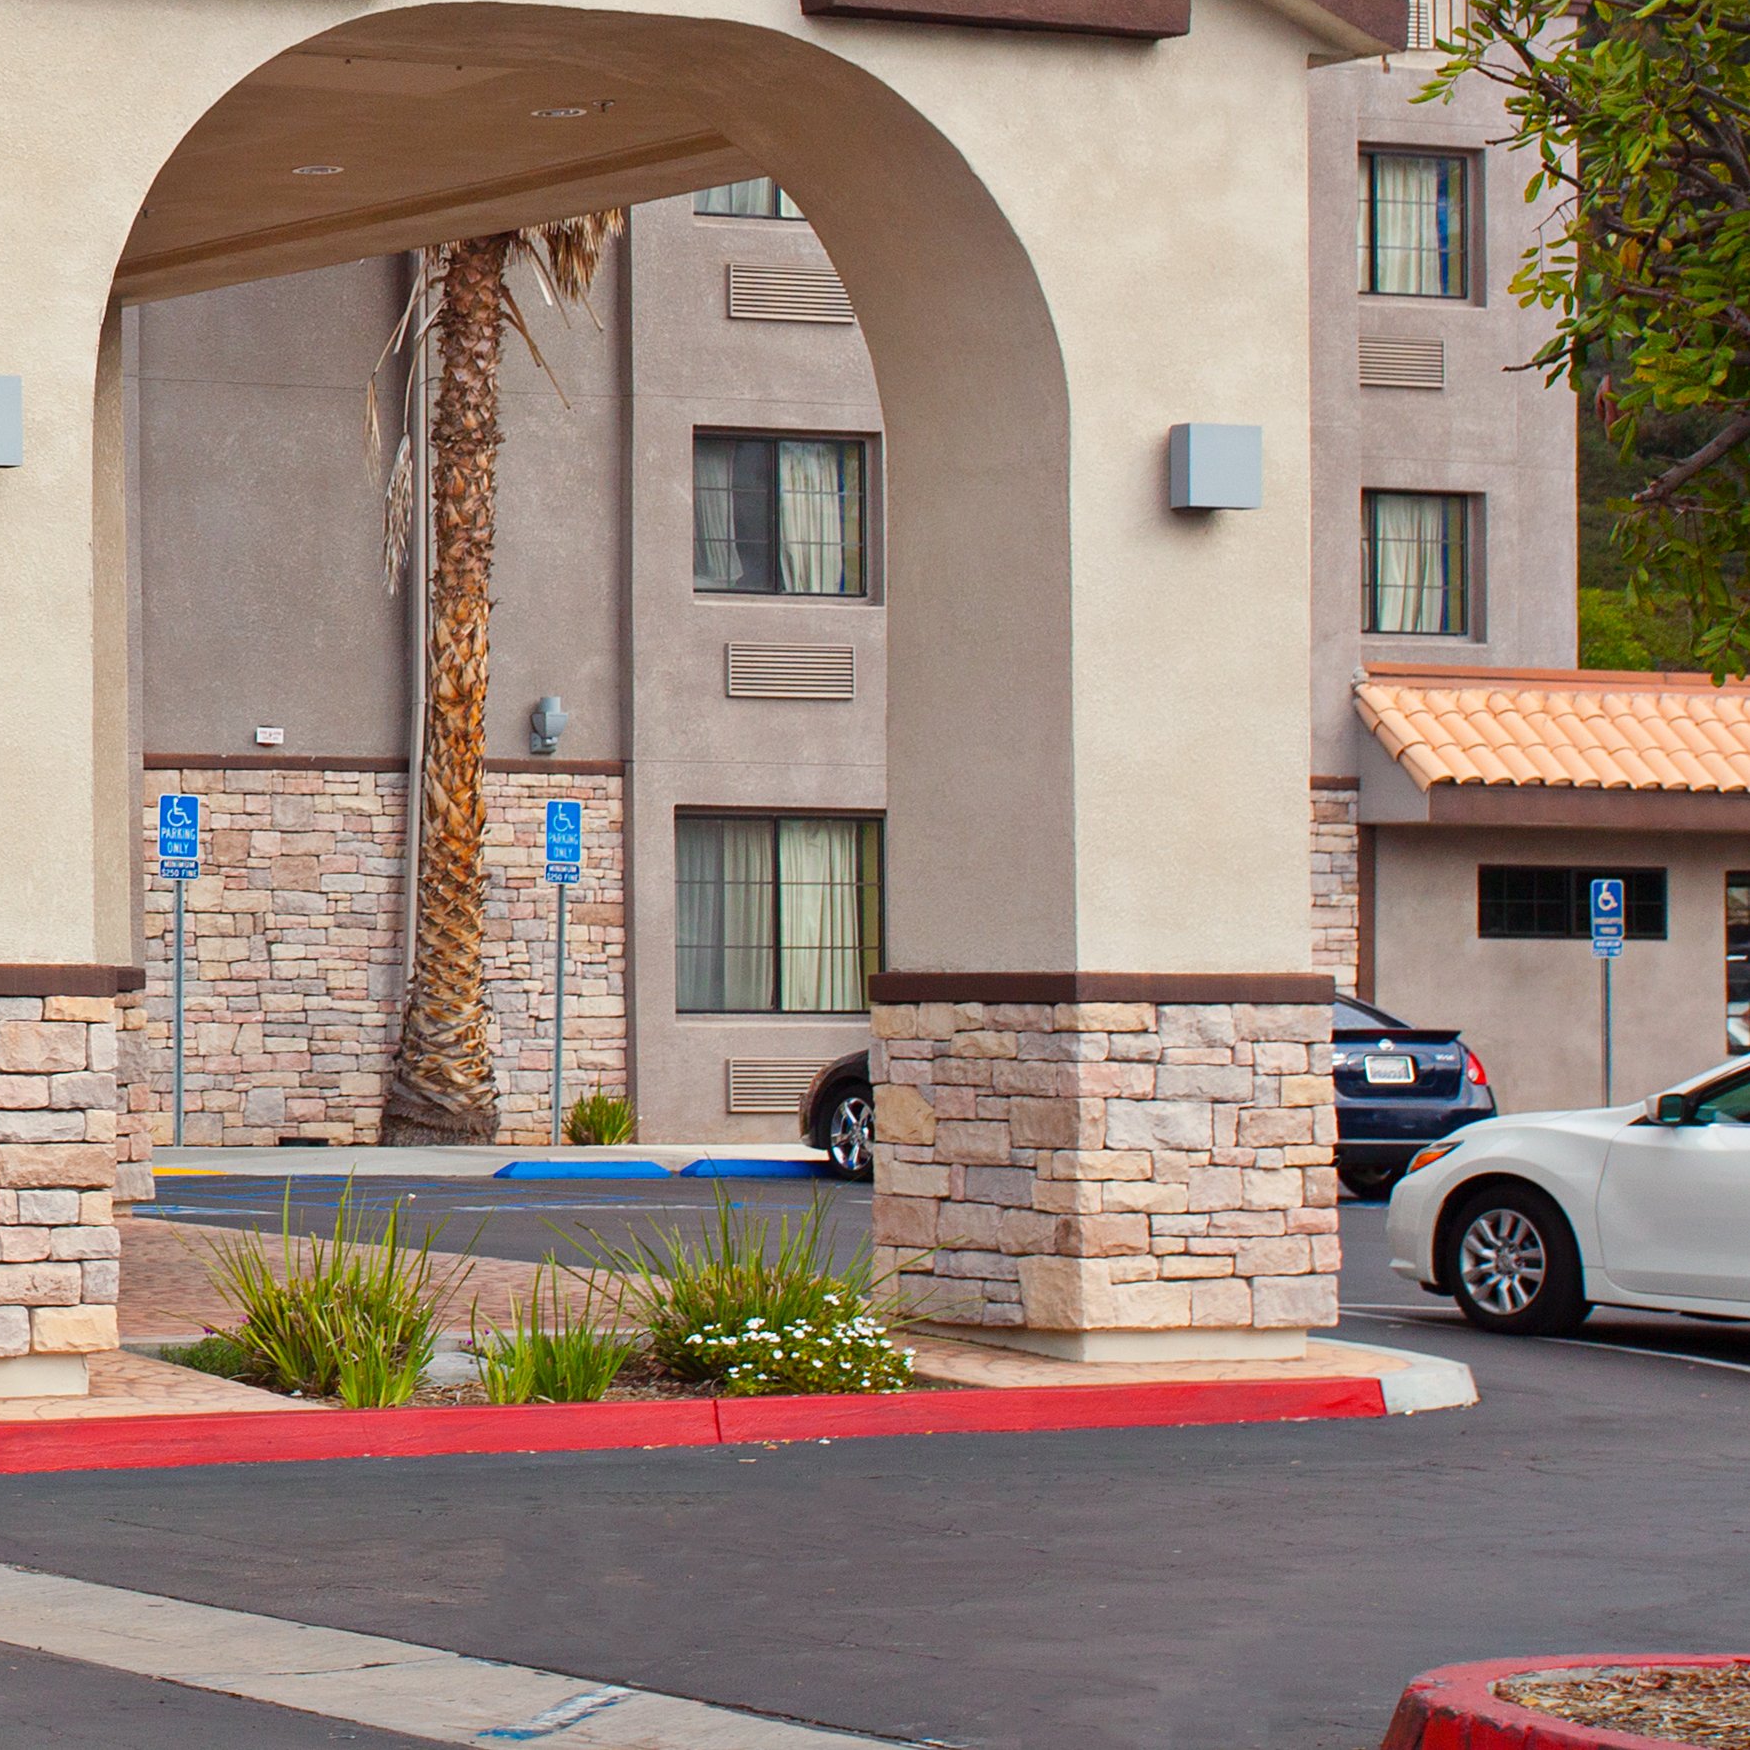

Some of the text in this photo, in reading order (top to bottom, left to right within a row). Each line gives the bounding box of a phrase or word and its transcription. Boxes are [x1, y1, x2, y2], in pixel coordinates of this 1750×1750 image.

[161, 827, 196, 841] PARKING
[548, 832, 579, 845] PARKING
[167, 841, 190, 854] ONLY
[553, 846, 573, 859] ONLY
[164, 860, 196, 869] MINIMUM
[548, 864, 577, 873] MINIMUM
[161, 868, 198, 878] $250 FINE
[547, 872, 579, 882] $250 FINE
